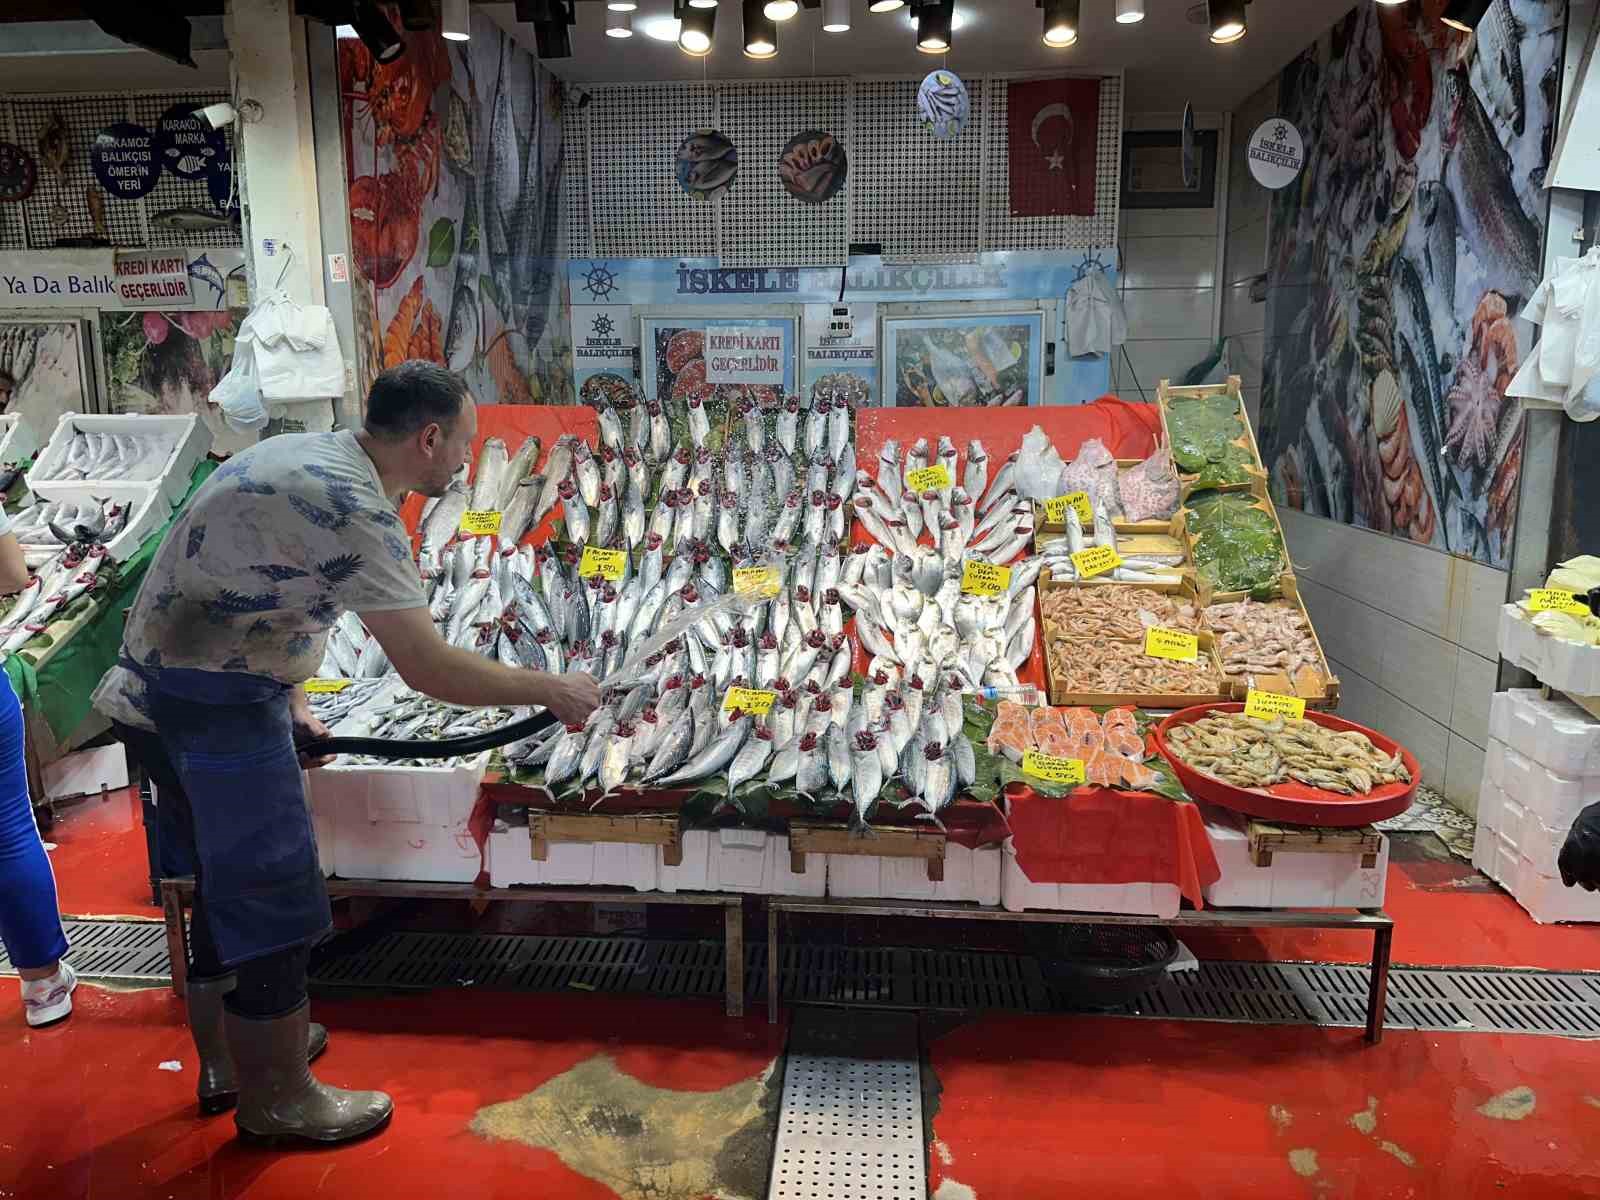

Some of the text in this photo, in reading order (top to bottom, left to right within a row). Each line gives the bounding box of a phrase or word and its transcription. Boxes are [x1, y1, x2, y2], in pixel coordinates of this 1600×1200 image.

[175, 132, 206, 145] MARKA
[117, 178, 141, 191] YERİ
[114, 256, 185, 276] KREDİ KARTI
[4, 274, 116, 294] Ya Da Balık
[676, 262, 799, 294] İSKELE
[121, 279, 188, 301] GEÇERLİDİR
[709, 332, 780, 351] KREDİ KARTI
[711, 354, 778, 374] GEÇERLİDİR
